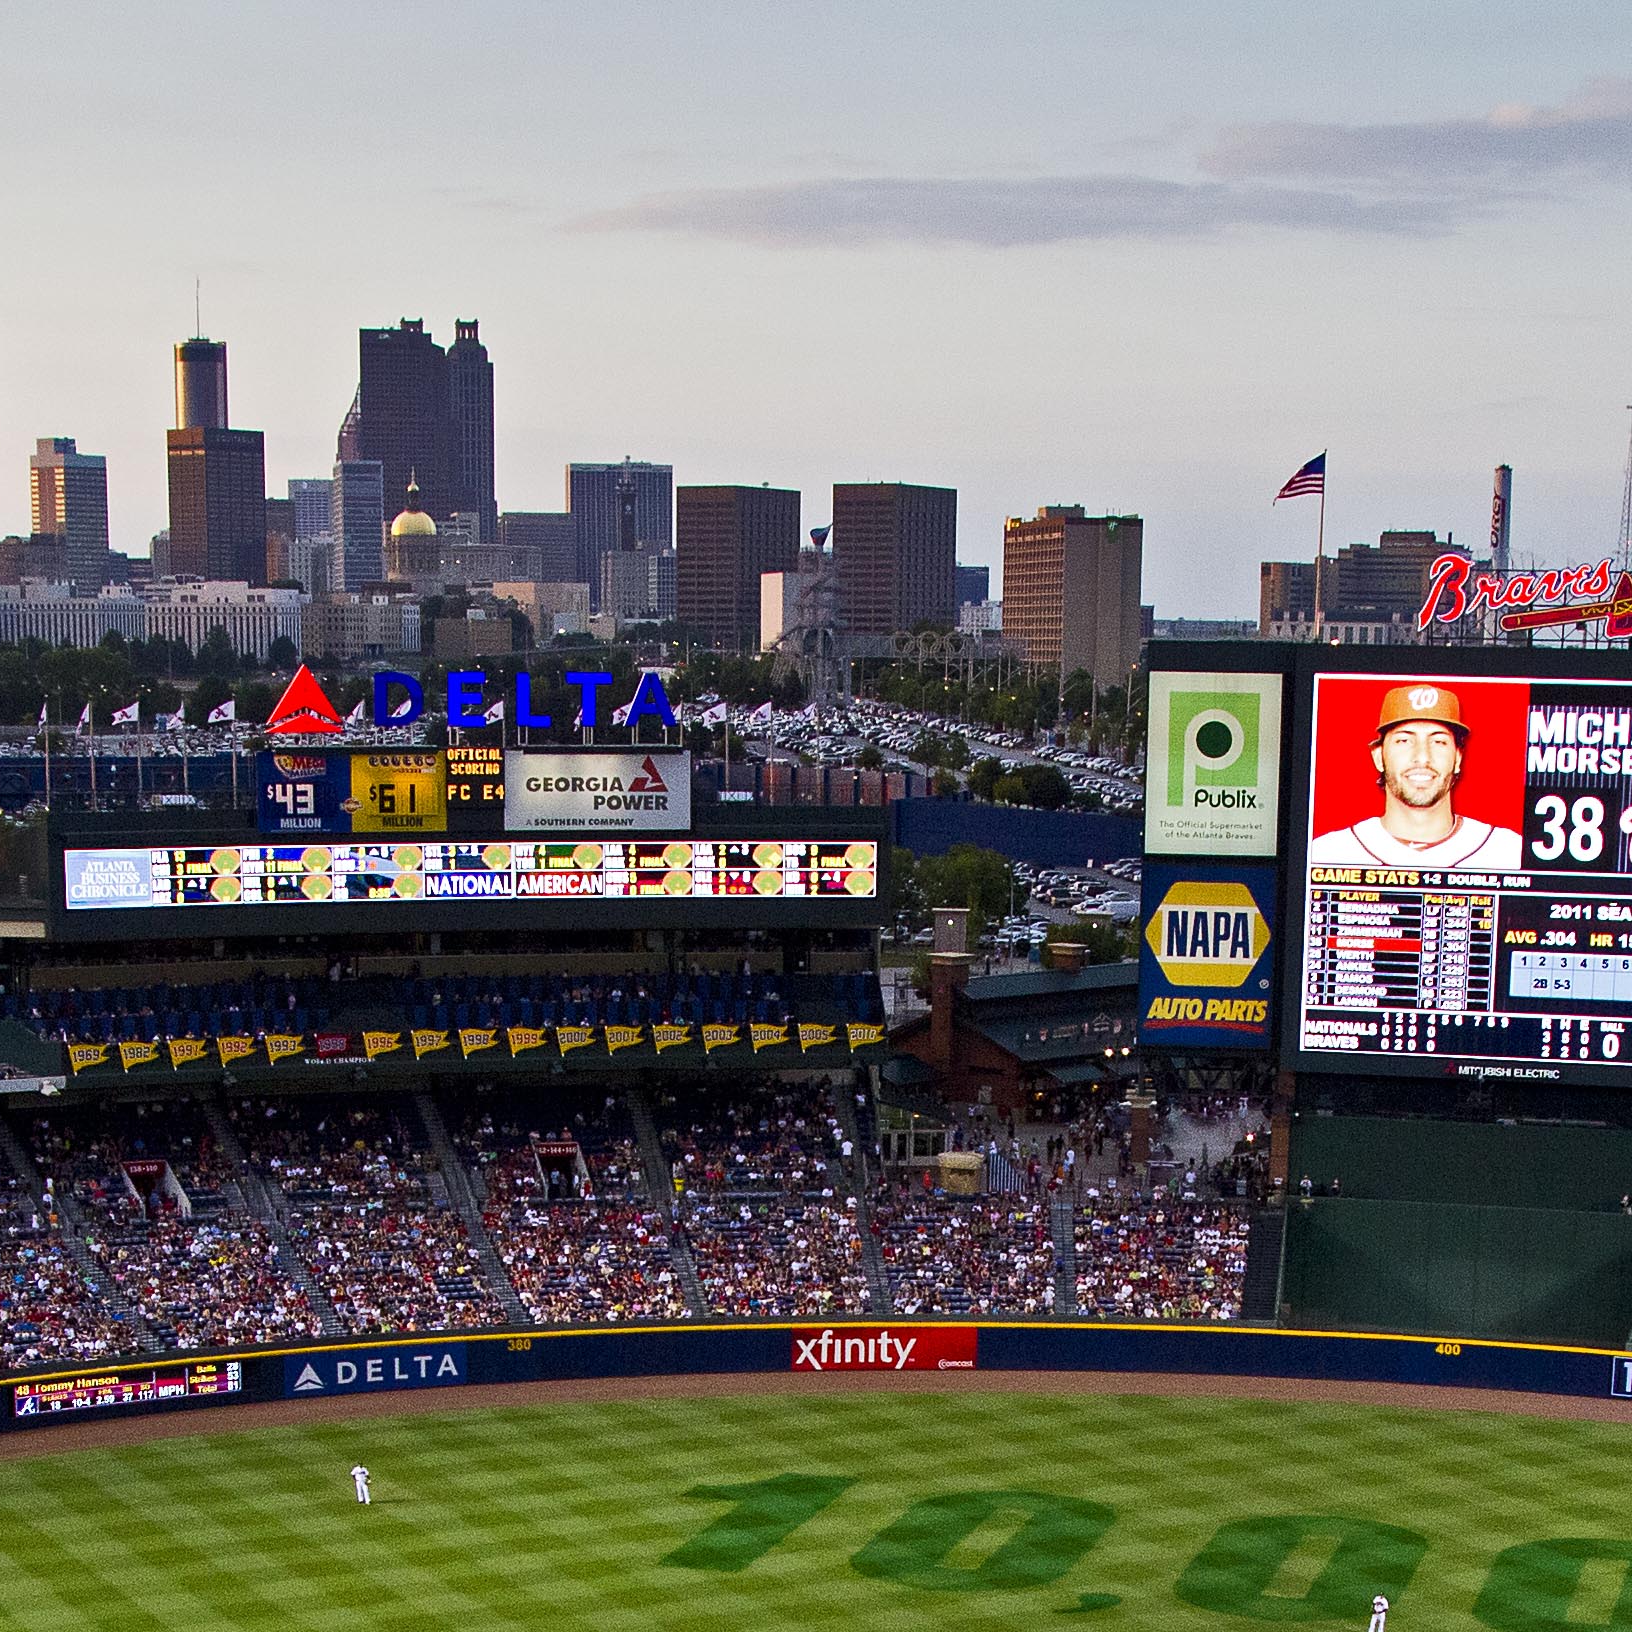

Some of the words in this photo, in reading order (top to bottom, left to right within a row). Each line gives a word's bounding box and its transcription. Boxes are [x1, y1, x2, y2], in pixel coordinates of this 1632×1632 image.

[1417, 554, 1615, 632] Braves
[373, 671, 678, 729] DELTA
[447, 749, 503, 761] OFFICIAL
[450, 762, 500, 775] SCORING
[447, 784, 471, 800] FC
[483, 784, 505, 800] E4
[526, 777, 623, 792] GEORGIA
[593, 795, 668, 811] POWER
[1195, 789, 1257, 809] Publix
[280, 818, 322, 829] MILLION
[382, 816, 424, 828] MILLION
[534, 818, 586, 827] SOUTHERN
[588, 818, 635, 827] COMPANY
[1159, 821, 1175, 829] The
[1176, 821, 1207, 829] Official
[1209, 821, 1263, 832] Supermarket
[1531, 794, 1604, 862] 38
[1176, 831, 1190, 839] the
[1192, 831, 1223, 839] Atlanta
[85, 860, 136, 875] ATLANTA
[81, 871, 139, 886] BUSINESS
[426, 874, 512, 895] NATIONAL
[518, 874, 604, 895] AMERICAN
[1312, 869, 1361, 883] GAME
[1365, 870, 1419, 885] STATS
[1423, 874, 1441, 885] 1-2
[1447, 874, 1501, 888] DOUBLE,
[1503, 876, 1531, 888] RUN
[71, 884, 148, 898] CHRONICLE
[1339, 892, 1380, 902] PLAYER
[1550, 904, 1592, 919] 2011
[1167, 911, 1250, 958] NAPA
[1504, 931, 1536, 944] AVG
[1540, 931, 1577, 946] .304
[1590, 934, 1613, 947] HR
[1522, 957, 1528, 967] 1
[1539, 957, 1546, 967] 2
[1560, 958, 1568, 968] 3
[1580, 958, 1588, 968] 4
[1601, 959, 1609, 969] 5
[1622, 959, 1629, 970] 6
[1554, 979, 1571, 990] 5-3
[1146, 997, 1204, 1020] AUTO
[1205, 999, 1268, 1023] PARTS
[752, 1028, 781, 1042] 2004
[849, 1027, 876, 1041] 2010
[1306, 1020, 1378, 1036] NATIONALS
[367, 1035, 393, 1050] 1996
[415, 1033, 442, 1048] 1997
[463, 1033, 489, 1047] 1998
[510, 1032, 538, 1046] 1999
[607, 1030, 635, 1044] 2001
[1305, 1036, 1359, 1049] BRAVES
[123, 1046, 151, 1060] 1982
[172, 1043, 199, 1058] 1991
[221, 1040, 248, 1055] 1992
[269, 1038, 297, 1053] 1993
[1602, 1034, 1619, 1058] 0
[72, 1047, 100, 1063] 1969
[1514, 1067, 1560, 1079] ELECTRIC
[795, 1329, 917, 1370] xfinity
[1435, 1343, 1461, 1357] 400
[336, 1353, 459, 1386] DELTA
[36, 1380, 75, 1395] Tommy
[77, 1376, 119, 1388] Hanson
[158, 1384, 185, 1397] MPH
[137, 1389, 155, 1401] 117
